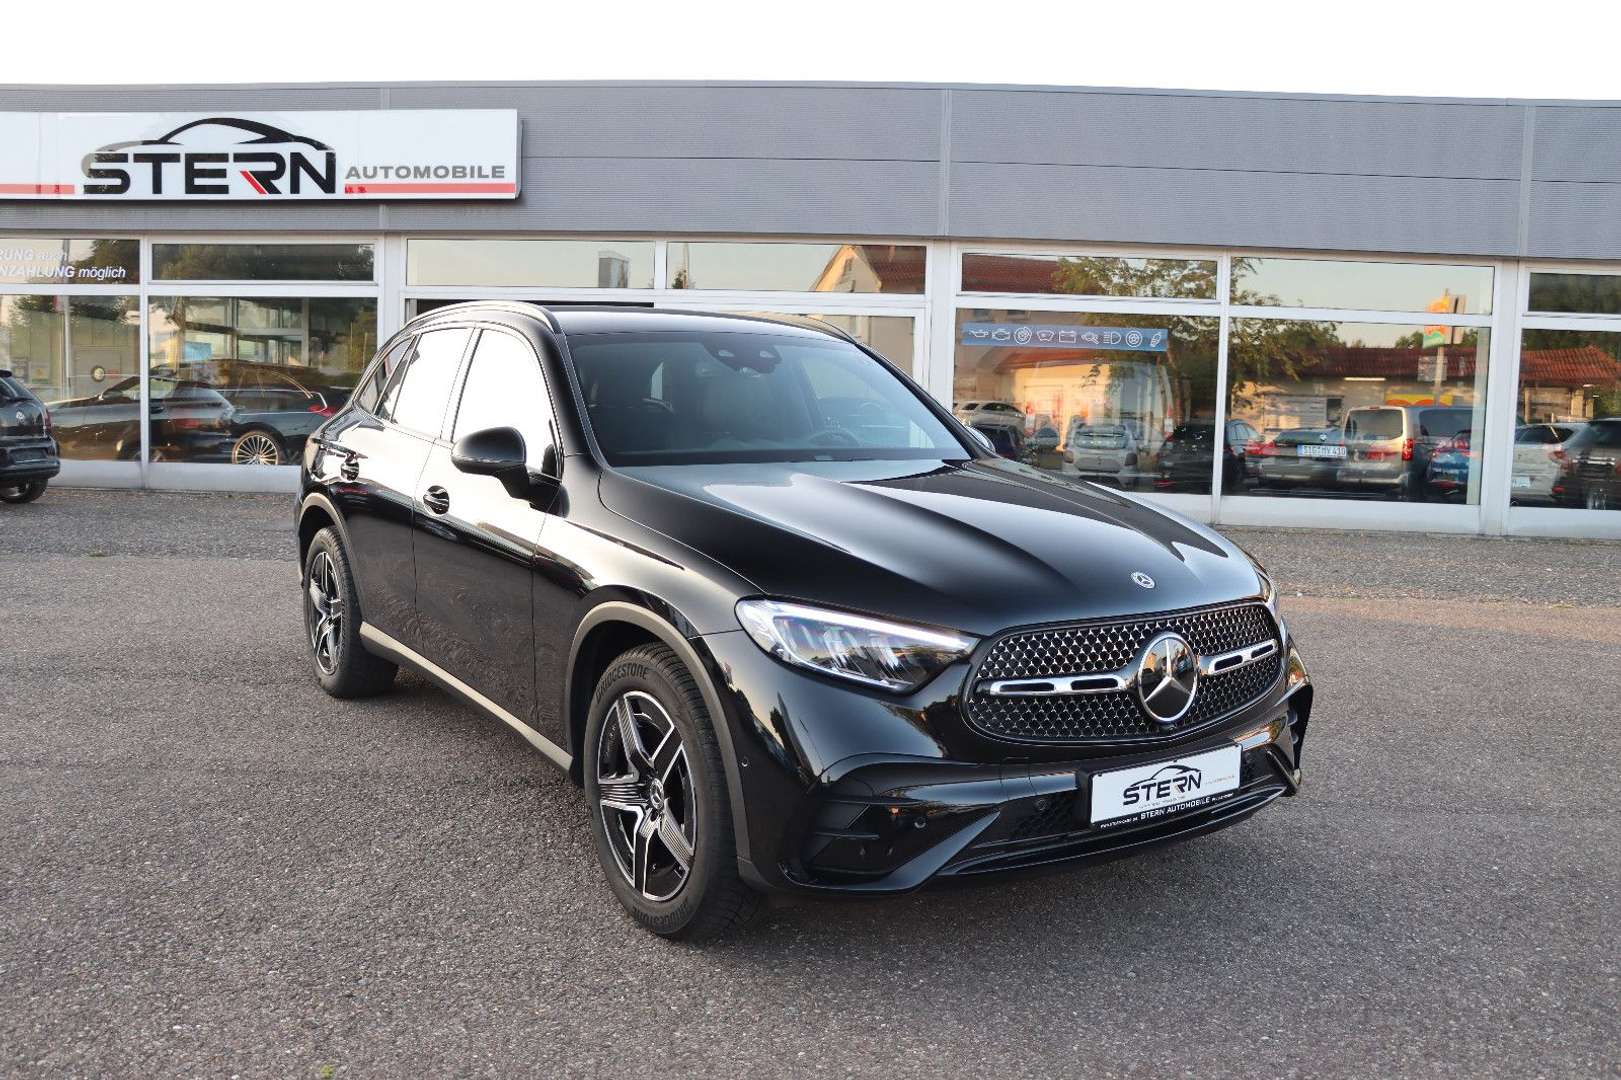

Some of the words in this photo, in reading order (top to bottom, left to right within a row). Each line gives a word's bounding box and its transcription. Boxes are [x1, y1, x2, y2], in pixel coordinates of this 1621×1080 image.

[82, 152, 336, 195] STERN
[345, 164, 506, 180] AUTOMOBILE
[78, 265, 126, 281] möglich
[595, 662, 648, 704] BRIDGESTONE
[1123, 771, 1202, 806] STERN
[1140, 807, 1166, 820] STERN
[1167, 796, 1210, 813] AUTOMOBILE
